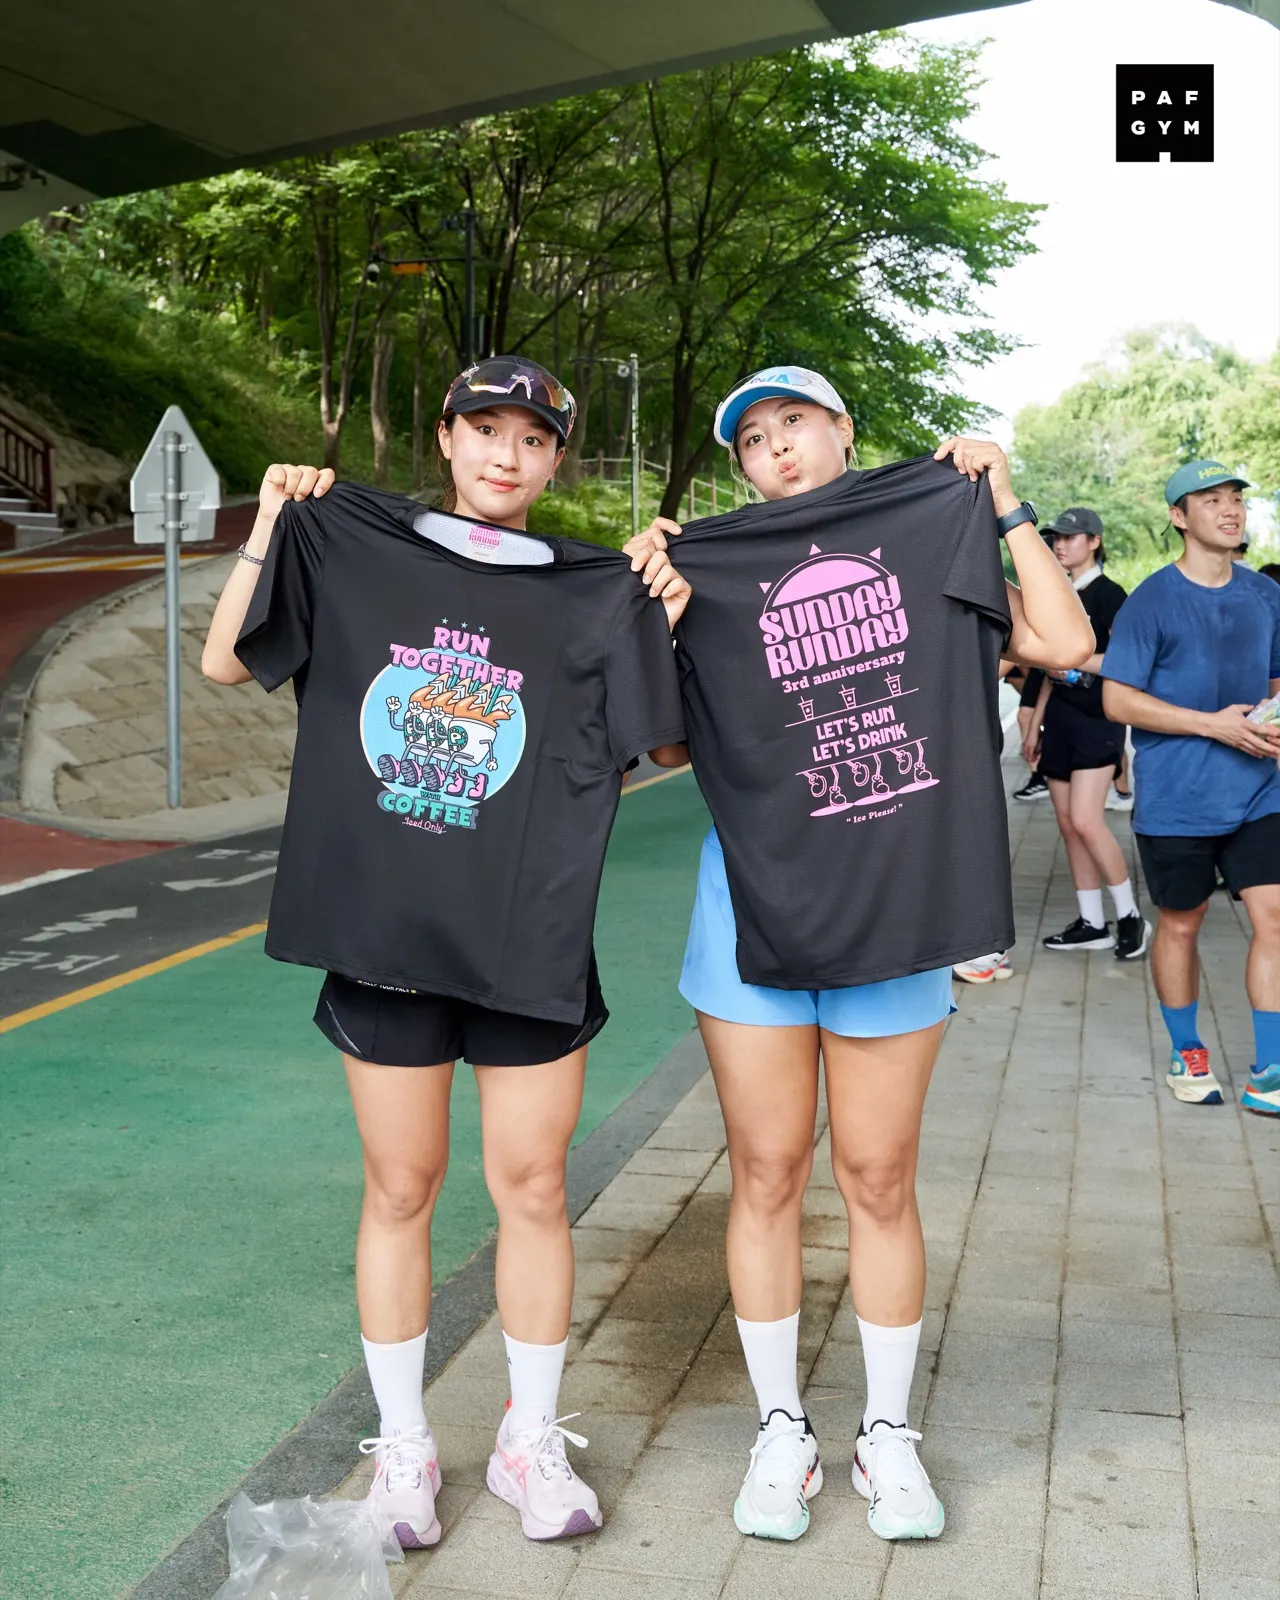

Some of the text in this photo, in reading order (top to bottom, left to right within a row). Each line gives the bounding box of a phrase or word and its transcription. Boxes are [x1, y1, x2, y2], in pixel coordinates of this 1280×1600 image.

[758, 574, 902, 645] SUNDAY
[433, 626, 491, 657] RUN
[765, 607, 909, 679] RUNDAY
[389, 643, 525, 692] TOGETHER
[782, 650, 906, 694] 3rd anniversary
[812, 722, 908, 763] LET'S DRINK
[815, 705, 896, 741] LET'S RUN
[377, 792, 478, 829] COFFEE
